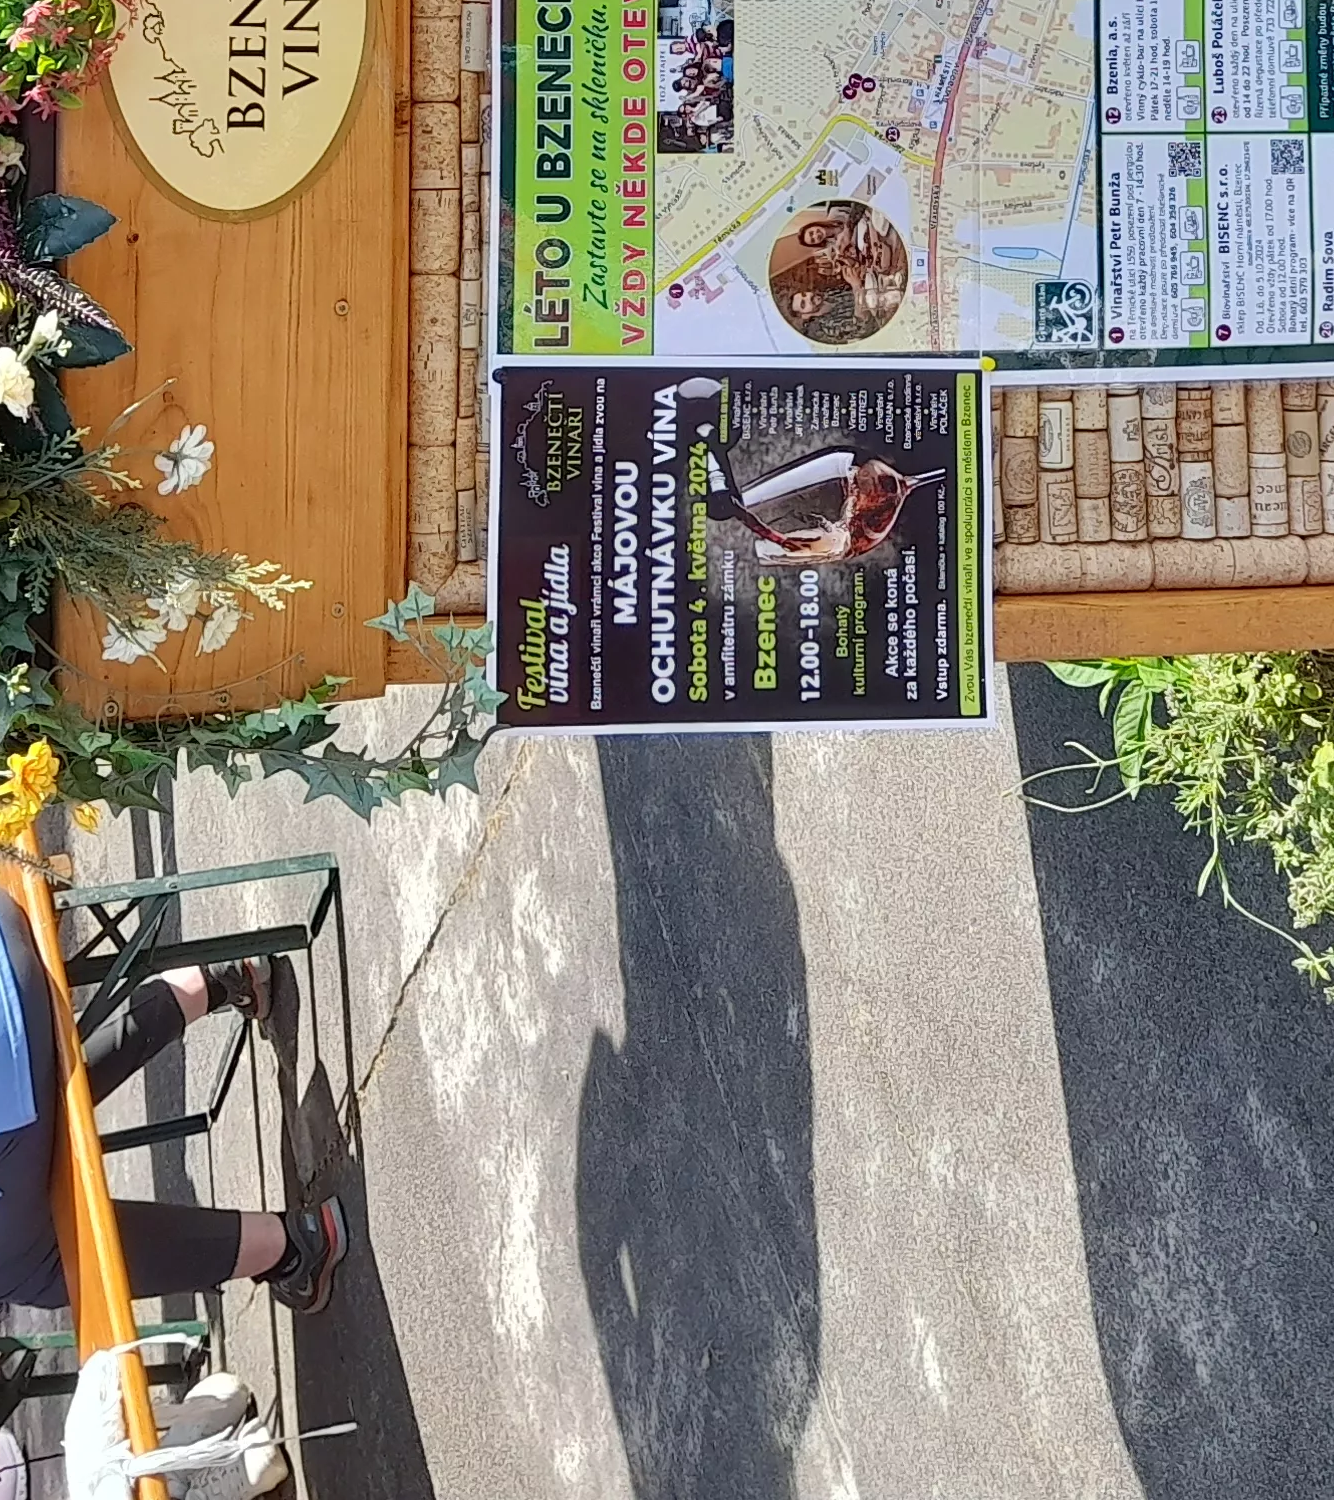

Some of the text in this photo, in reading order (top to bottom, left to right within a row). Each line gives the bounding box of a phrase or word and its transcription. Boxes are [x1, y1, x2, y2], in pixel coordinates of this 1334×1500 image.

[581, 4, 609, 125] skleničku.
[1212, 52, 1225, 95] Luboš
[589, 130, 608, 161] na
[614, 96, 647, 228] NĚKDE
[535, 195, 572, 224] U
[588, 168, 609, 194] se
[582, 199, 609, 310] Zastavte
[1108, 172, 1123, 320] Vinařství Petr Bunža
[1217, 202, 1230, 254] BISENC
[523, 237, 572, 348] LÉTO
[614, 242, 647, 346] VŽDY
[1322, 230, 1334, 312] Radim Sova
[595, 396, 605, 425] zvou
[596, 378, 606, 393] na
[960, 384, 971, 427] Bzenec
[543, 391, 564, 493] BZENEČTÍ
[565, 406, 584, 480] VINAŘI
[885, 401, 894, 443] FLORIAN
[595, 455, 604, 463] a
[689, 441, 708, 496] 2024
[960, 429, 972, 475] městem
[590, 493, 604, 541] Festival
[607, 460, 639, 624] MÁJOVOU
[645, 383, 678, 703] OCHUTNÁVKU VÍNA
[687, 502, 708, 580] května
[960, 486, 975, 544] spolupráci
[592, 543, 603, 573] akce
[963, 547, 974, 561] ve
[541, 543, 578, 703] vína a jídla
[720, 549, 735, 700] v amfiteátru zámku
[754, 575, 777, 690] Bzenec
[835, 605, 851, 658] Bohatý
[852, 567, 868, 696] kulturní program.
[884, 567, 899, 678] Akce se koná
[901, 545, 918, 700] za každého počasí.
[935, 598, 948, 656] zdarma.
[517, 597, 546, 710] Festival
[688, 619, 708, 702] Sobota
[935, 658, 951, 700] Vstup
[962, 648, 975, 671] Vás
[963, 673, 975, 704] Zvou
